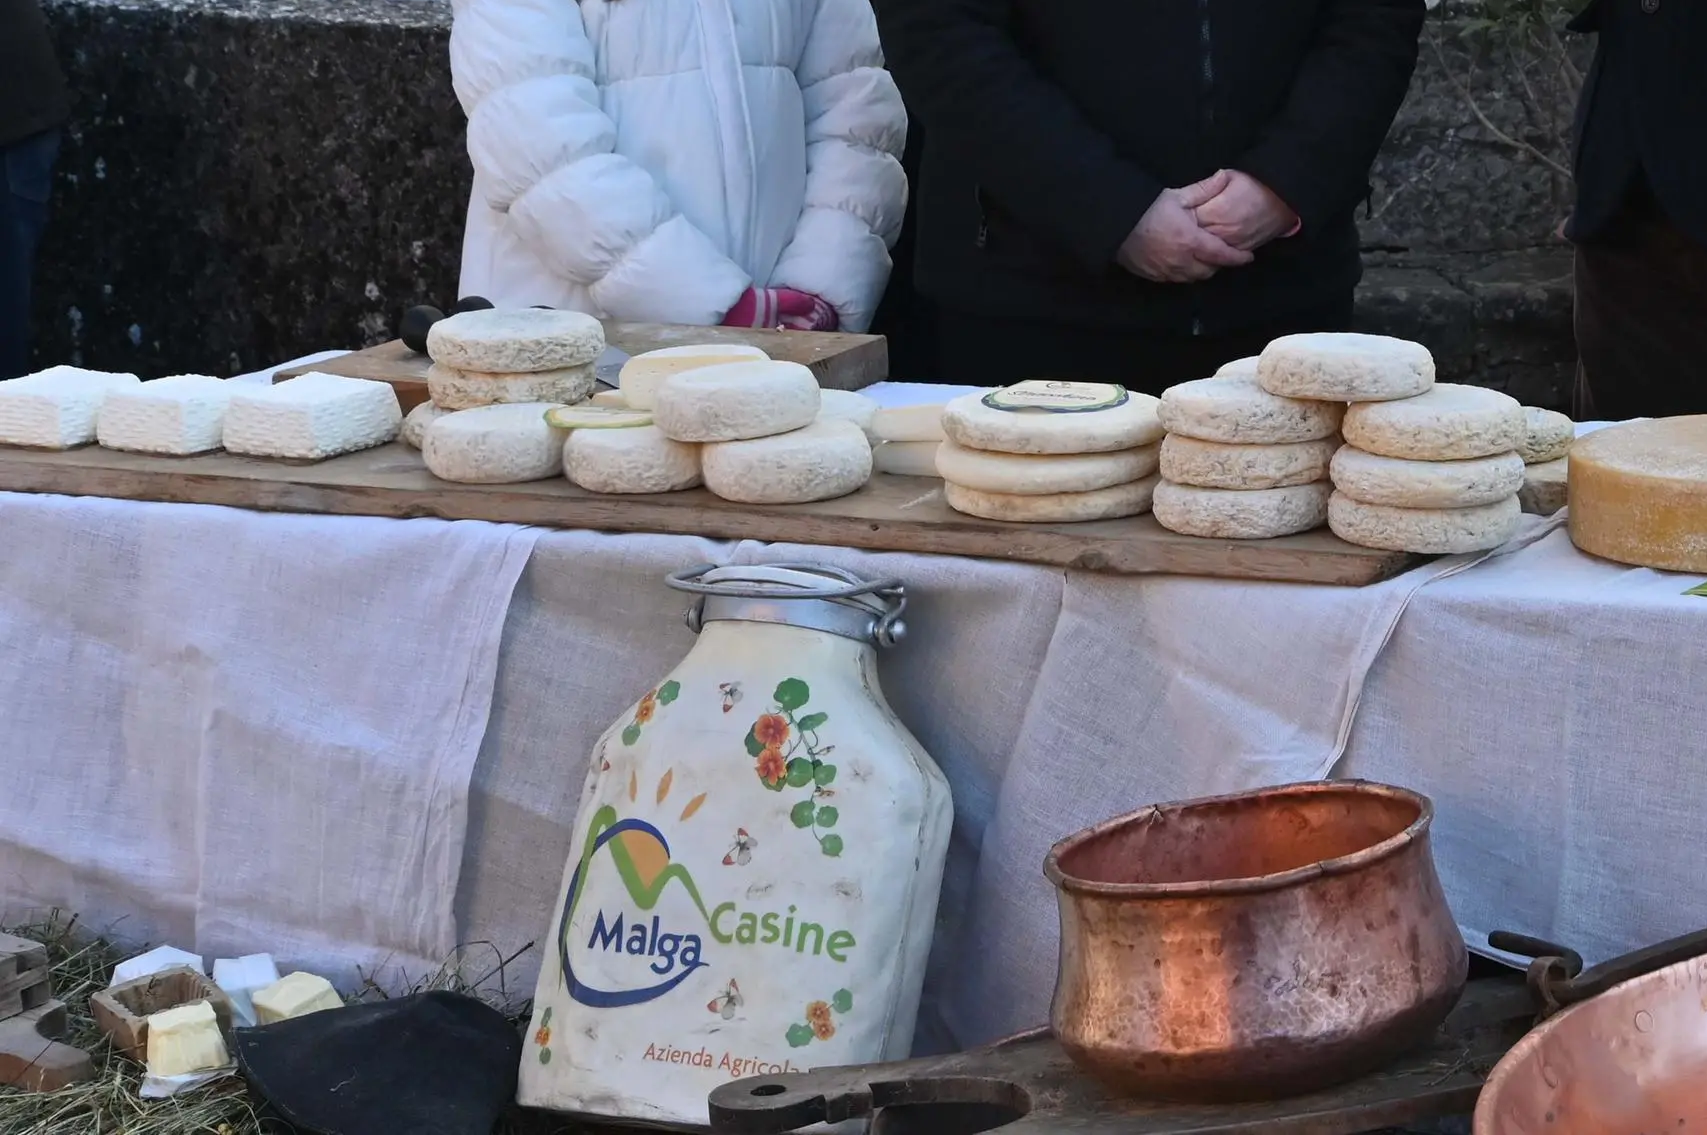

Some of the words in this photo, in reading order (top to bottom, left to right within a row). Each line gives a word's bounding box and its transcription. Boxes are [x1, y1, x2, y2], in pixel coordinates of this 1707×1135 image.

[588, 908, 703, 975] Malga
[708, 900, 857, 963] Casine
[642, 1041, 713, 1068] Azienda
